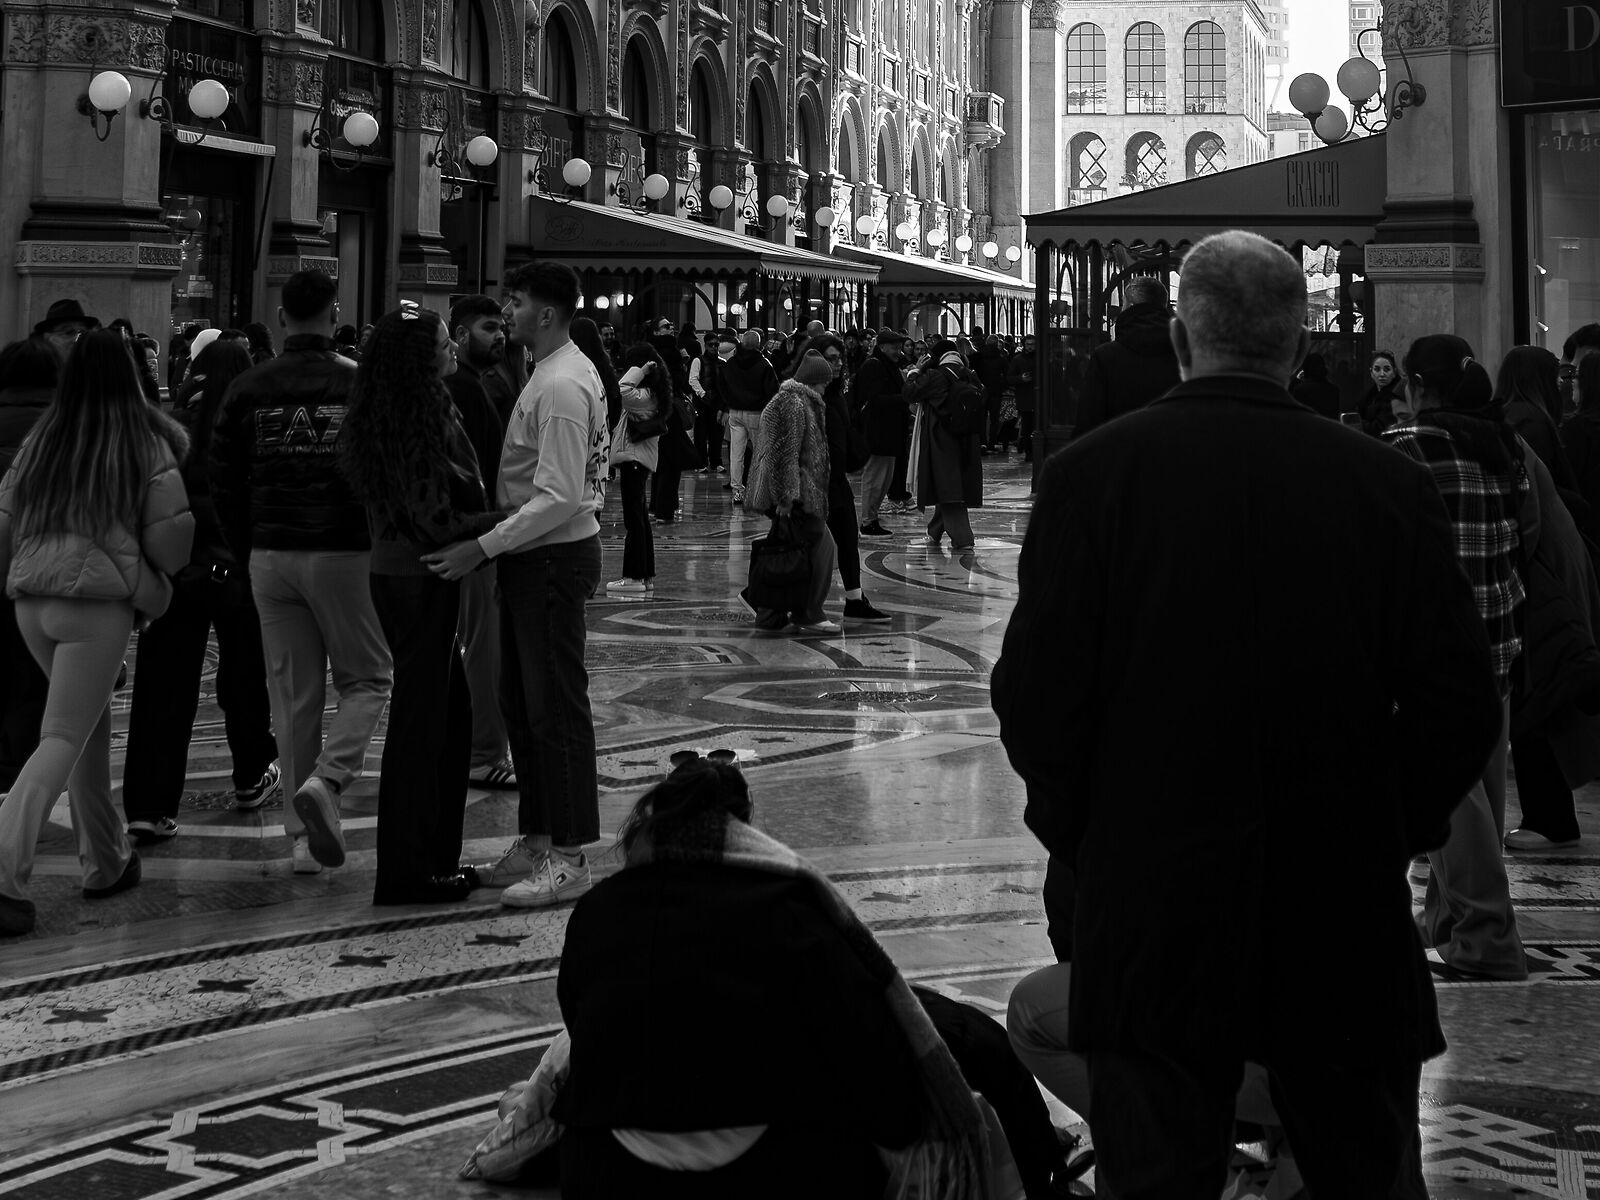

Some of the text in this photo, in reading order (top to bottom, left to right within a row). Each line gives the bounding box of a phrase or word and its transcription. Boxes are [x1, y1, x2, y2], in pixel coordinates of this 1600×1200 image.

[172, 48, 246, 83] PASTICCERIA
[1286, 160, 1340, 208] CRACCO
[255, 405, 350, 446] EA7
